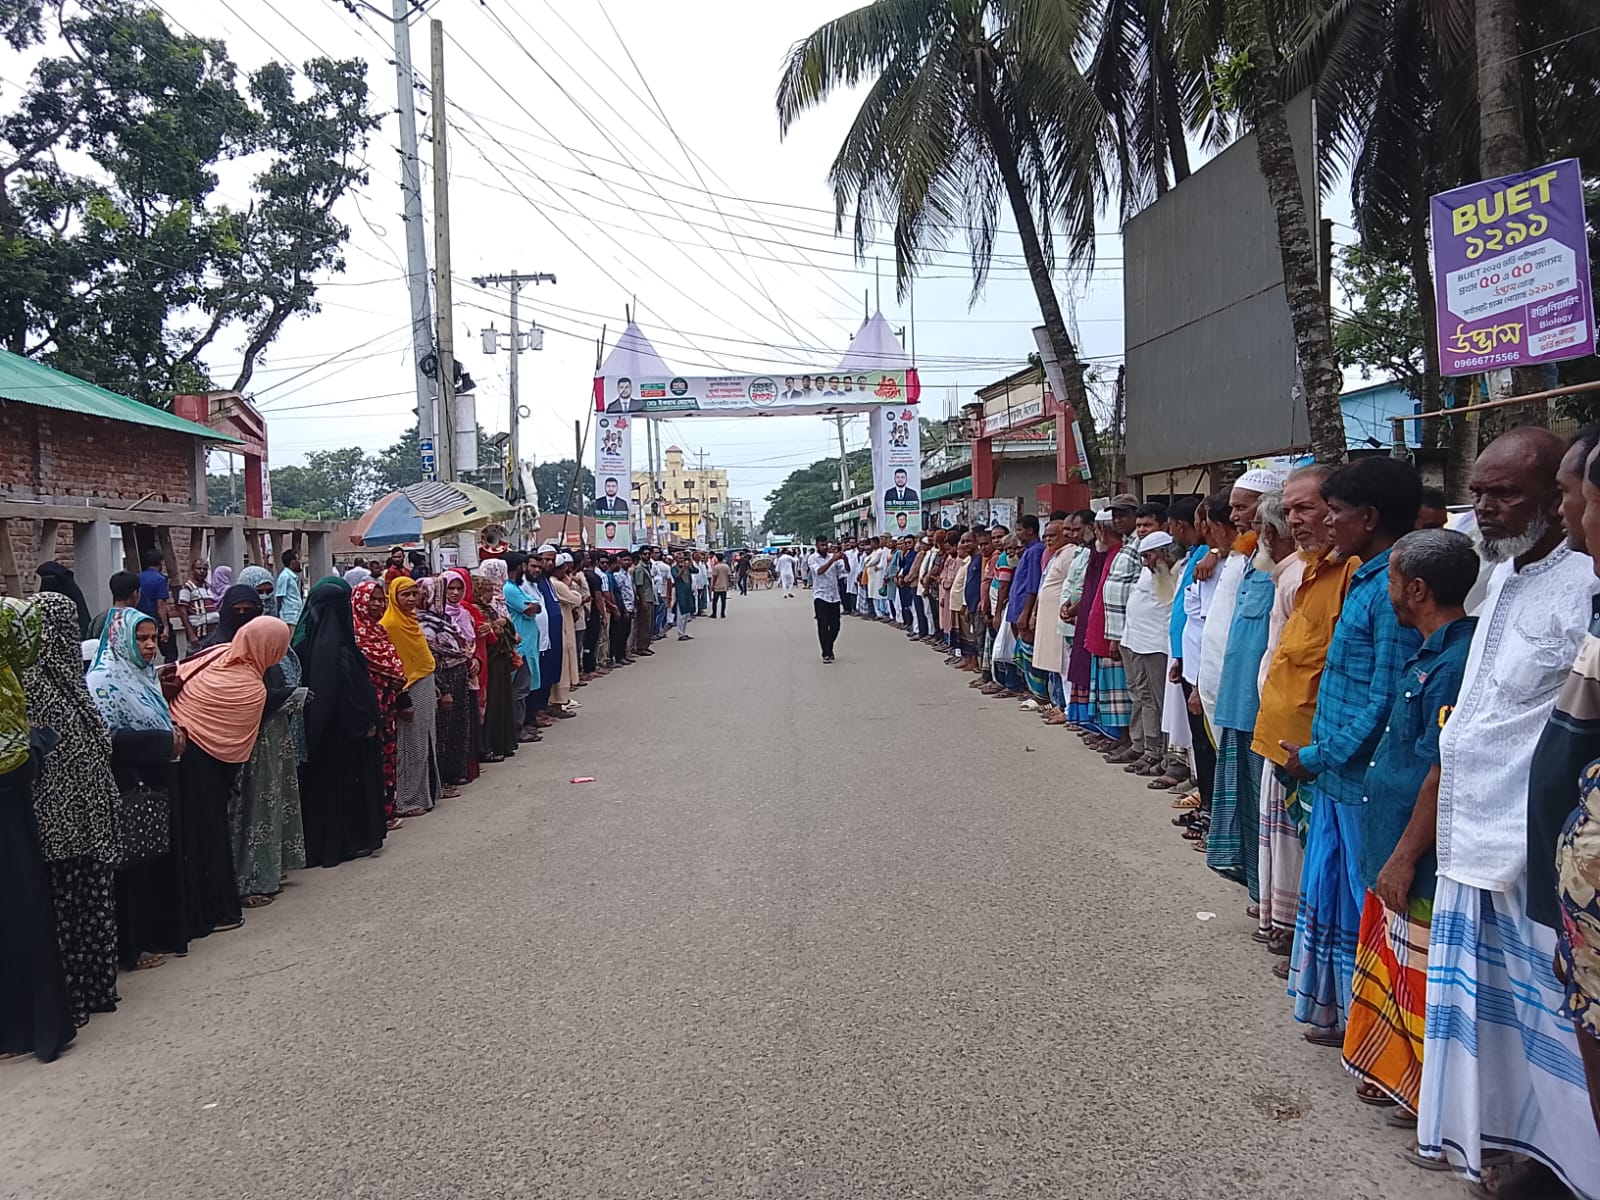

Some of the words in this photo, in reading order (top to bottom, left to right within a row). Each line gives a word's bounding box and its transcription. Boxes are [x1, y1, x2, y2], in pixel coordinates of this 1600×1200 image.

[1453, 170, 1557, 236] BUET
[1466, 213, 1548, 259] ১২৯১
[1457, 267, 1481, 282] BUET
[1479, 273, 1500, 288] ৫০
[1511, 262, 1533, 278] ৫০
[1528, 282, 1554, 297] ১২৯১
[1539, 313, 1573, 329] Biology
[1446, 323, 1524, 354] উদ্ভাস
[1454, 351, 1520, 368] 09666775566
